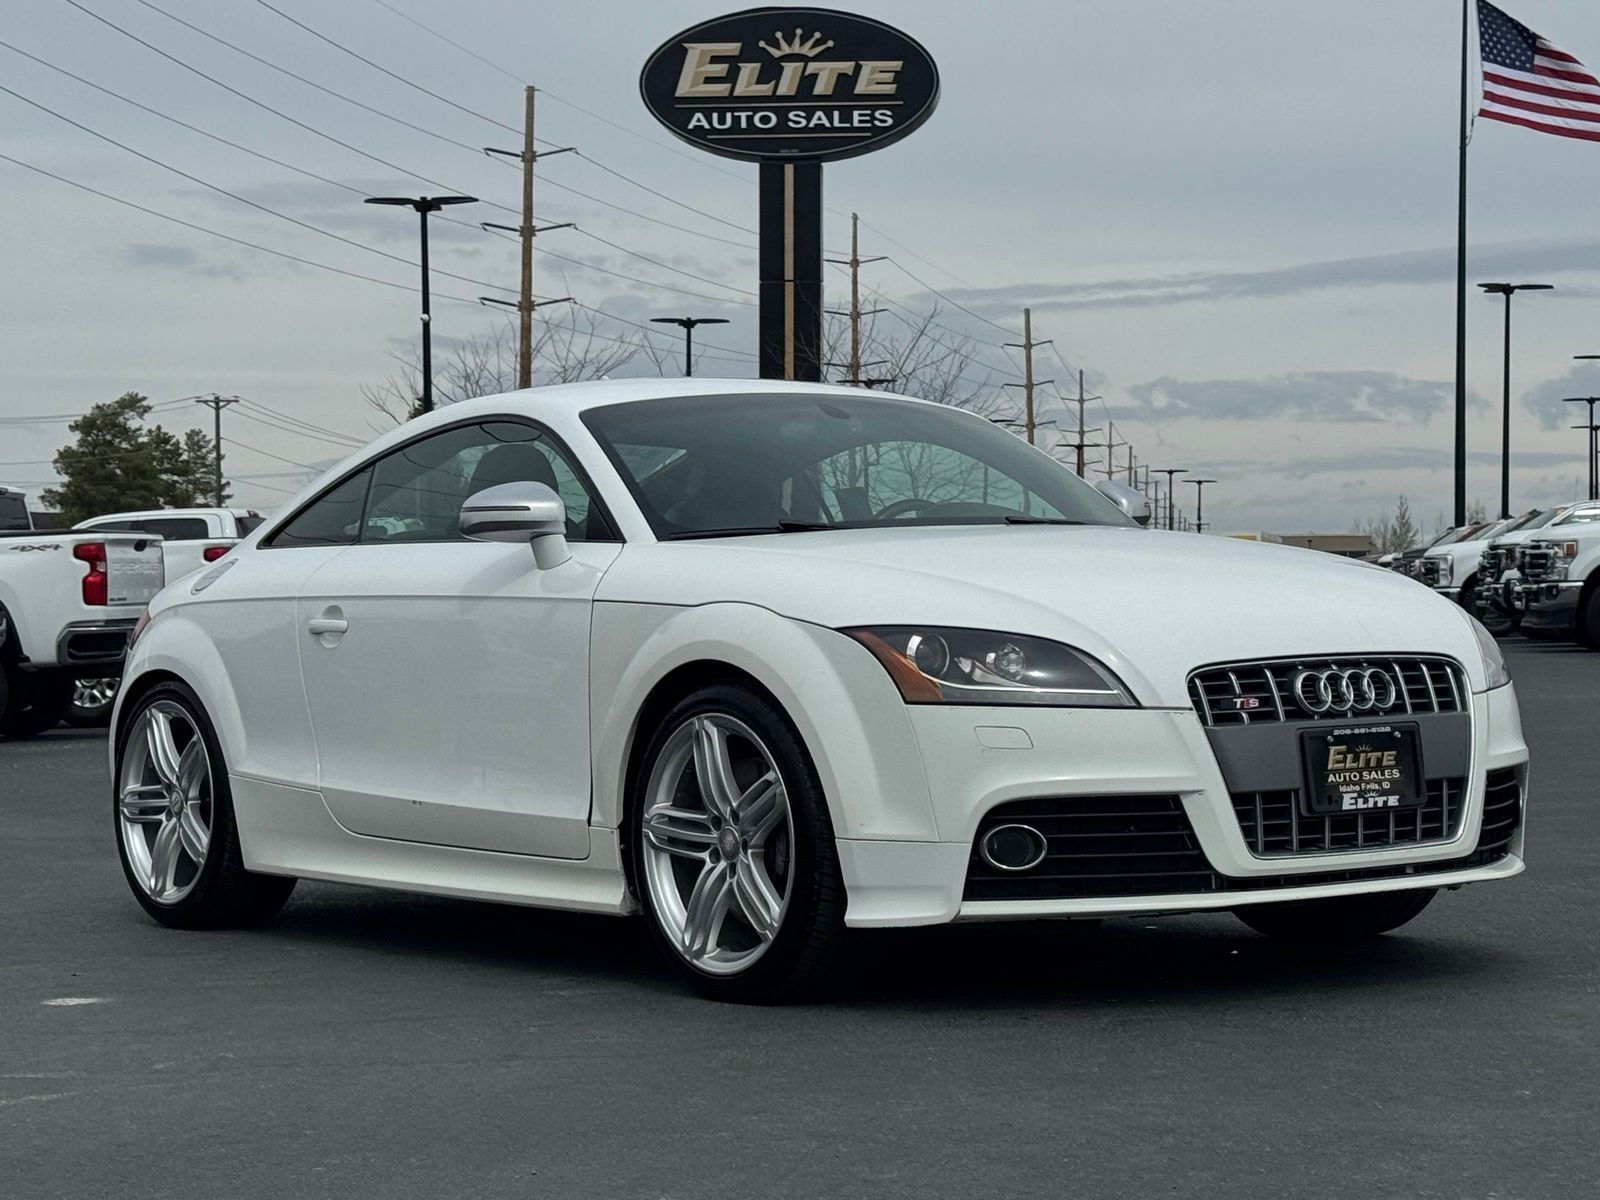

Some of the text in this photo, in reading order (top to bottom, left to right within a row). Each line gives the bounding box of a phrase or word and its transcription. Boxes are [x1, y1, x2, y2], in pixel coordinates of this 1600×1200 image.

[674, 42, 904, 97] ELITE
[687, 110, 894, 130] AUTO SALES
[1328, 769, 1400, 783] AUTO SALES
[1339, 784, 1360, 792] Idaho
[1382, 781, 1391, 789] ID
